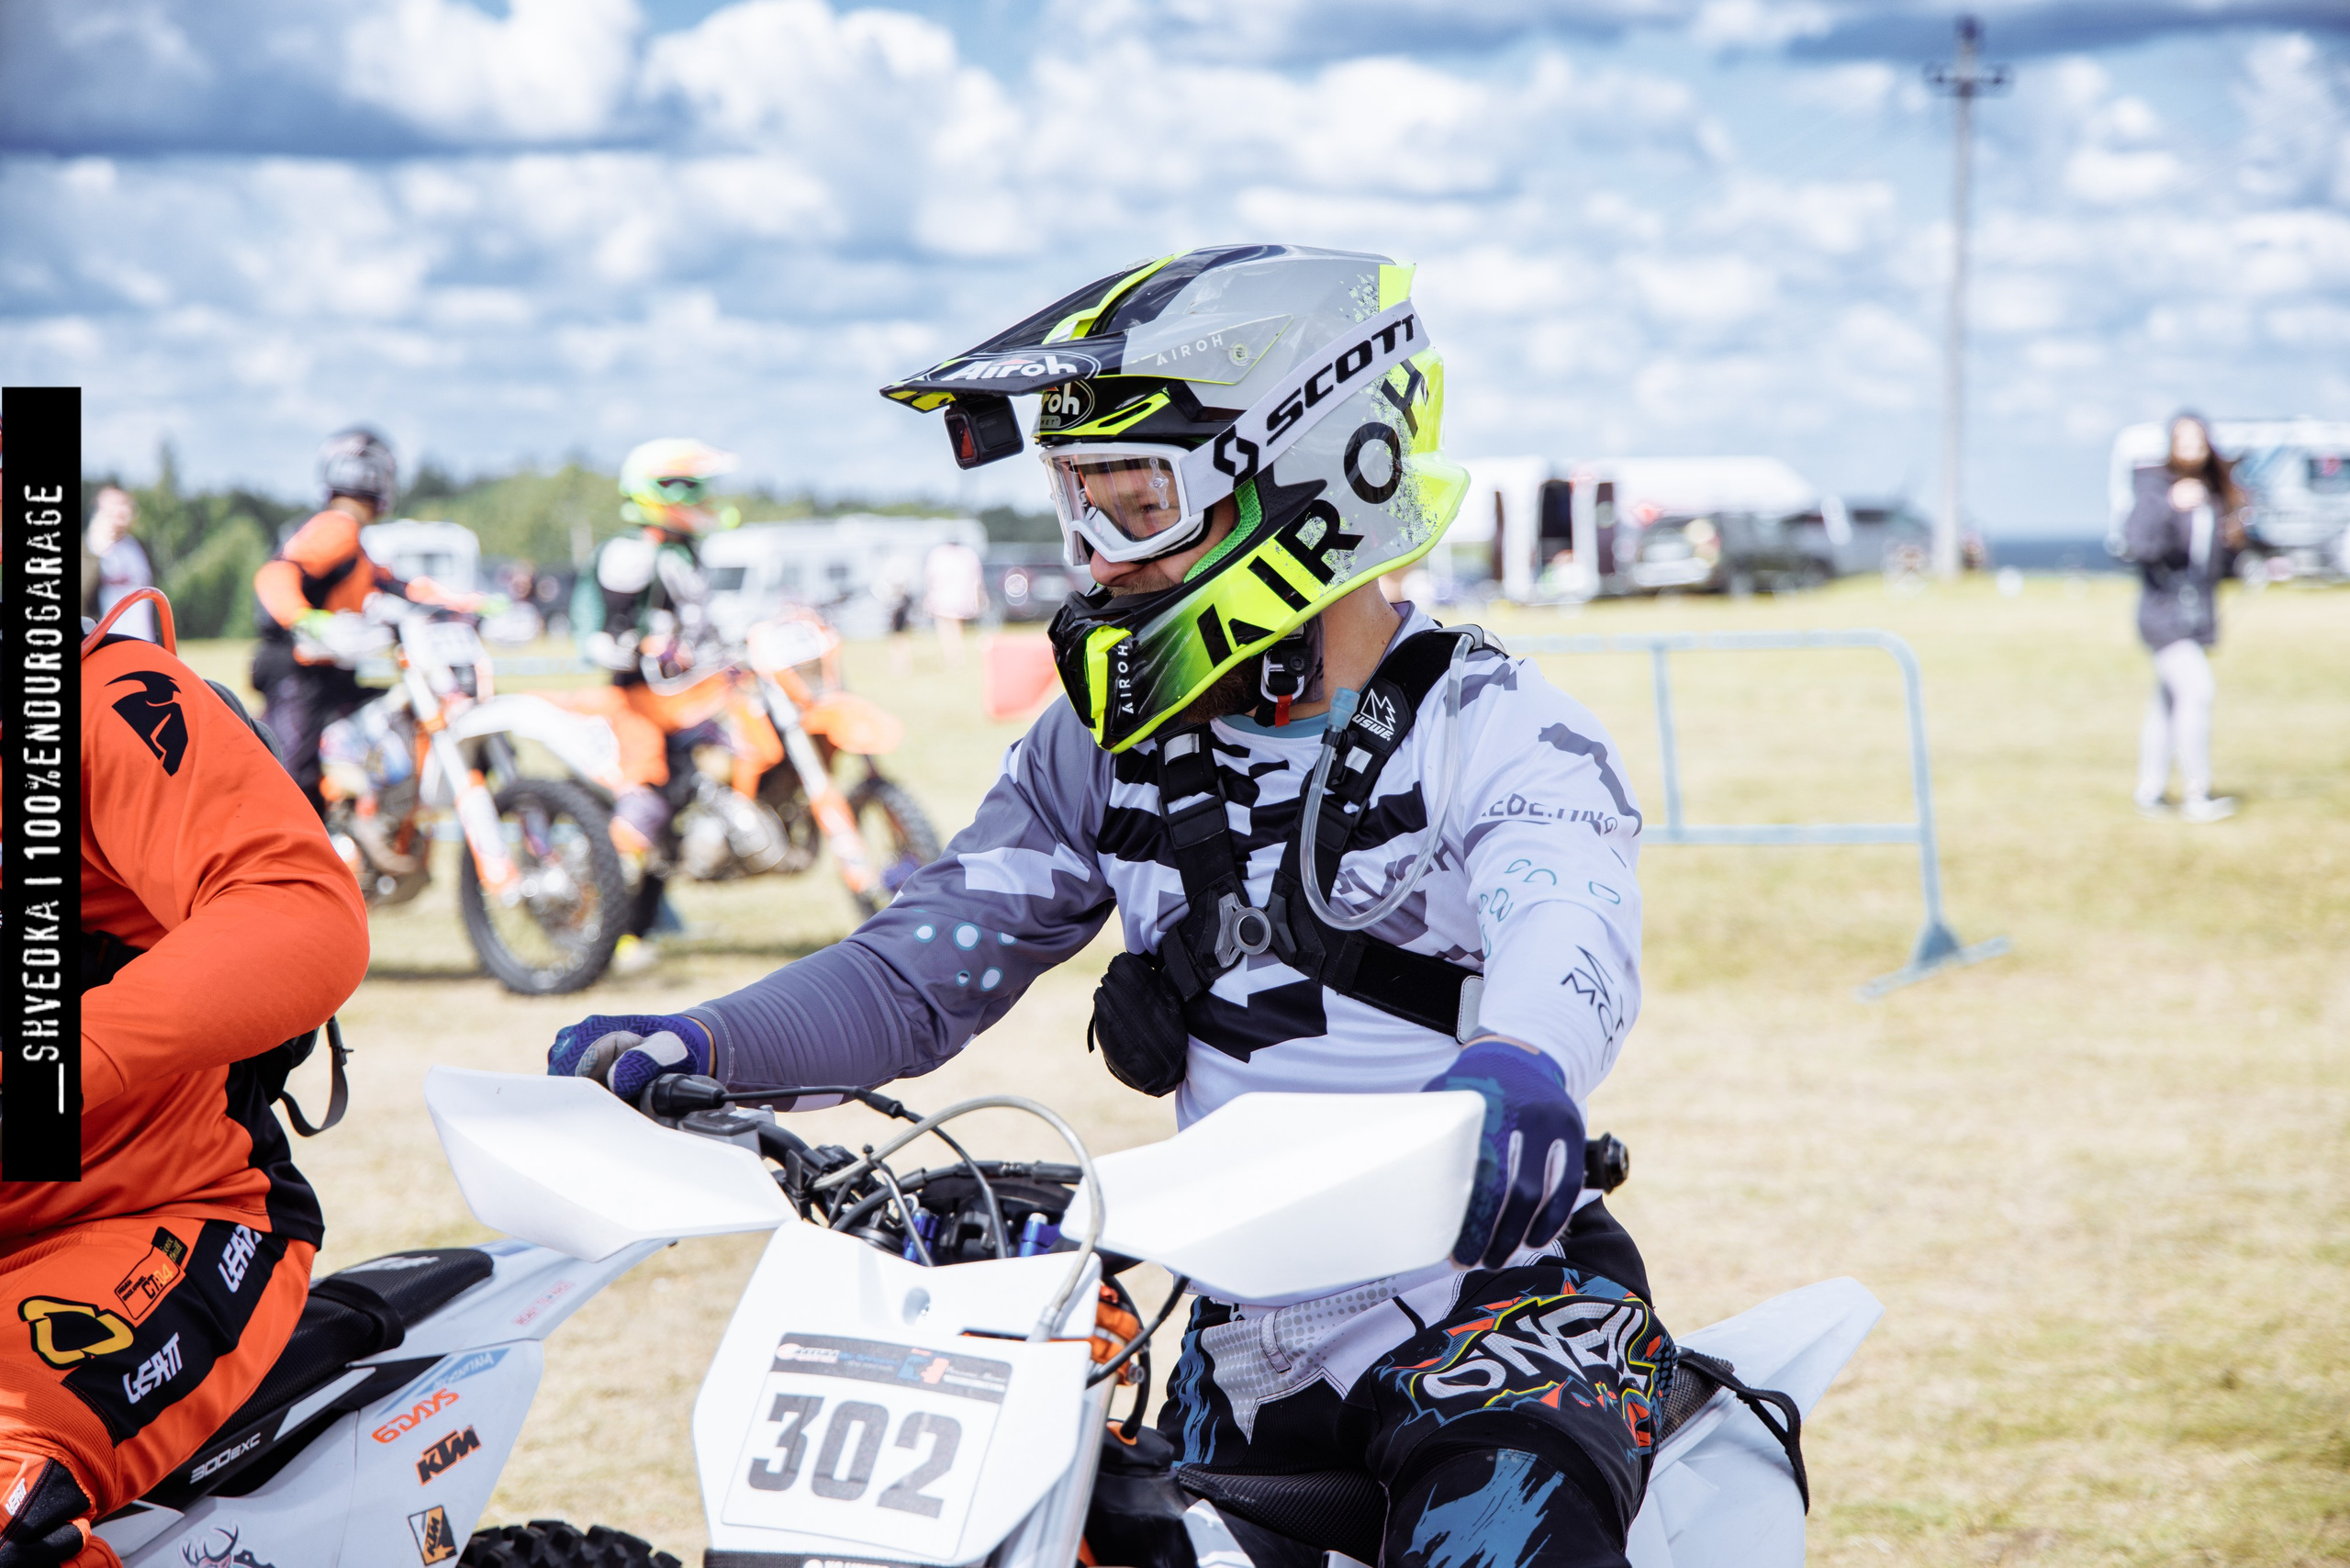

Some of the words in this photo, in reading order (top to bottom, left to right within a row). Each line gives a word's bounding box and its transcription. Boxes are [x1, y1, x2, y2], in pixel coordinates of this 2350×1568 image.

[1157, 334, 1223, 366] AIROH
[1266, 313, 1415, 447] SCOTT
[1117, 644, 1135, 714] AIROH
[122, 1331, 183, 1405] LEATT
[415, 1425, 482, 1486] KTM
[747, 1392, 963, 1519] 302
[426, 1516, 442, 1558] KTM
